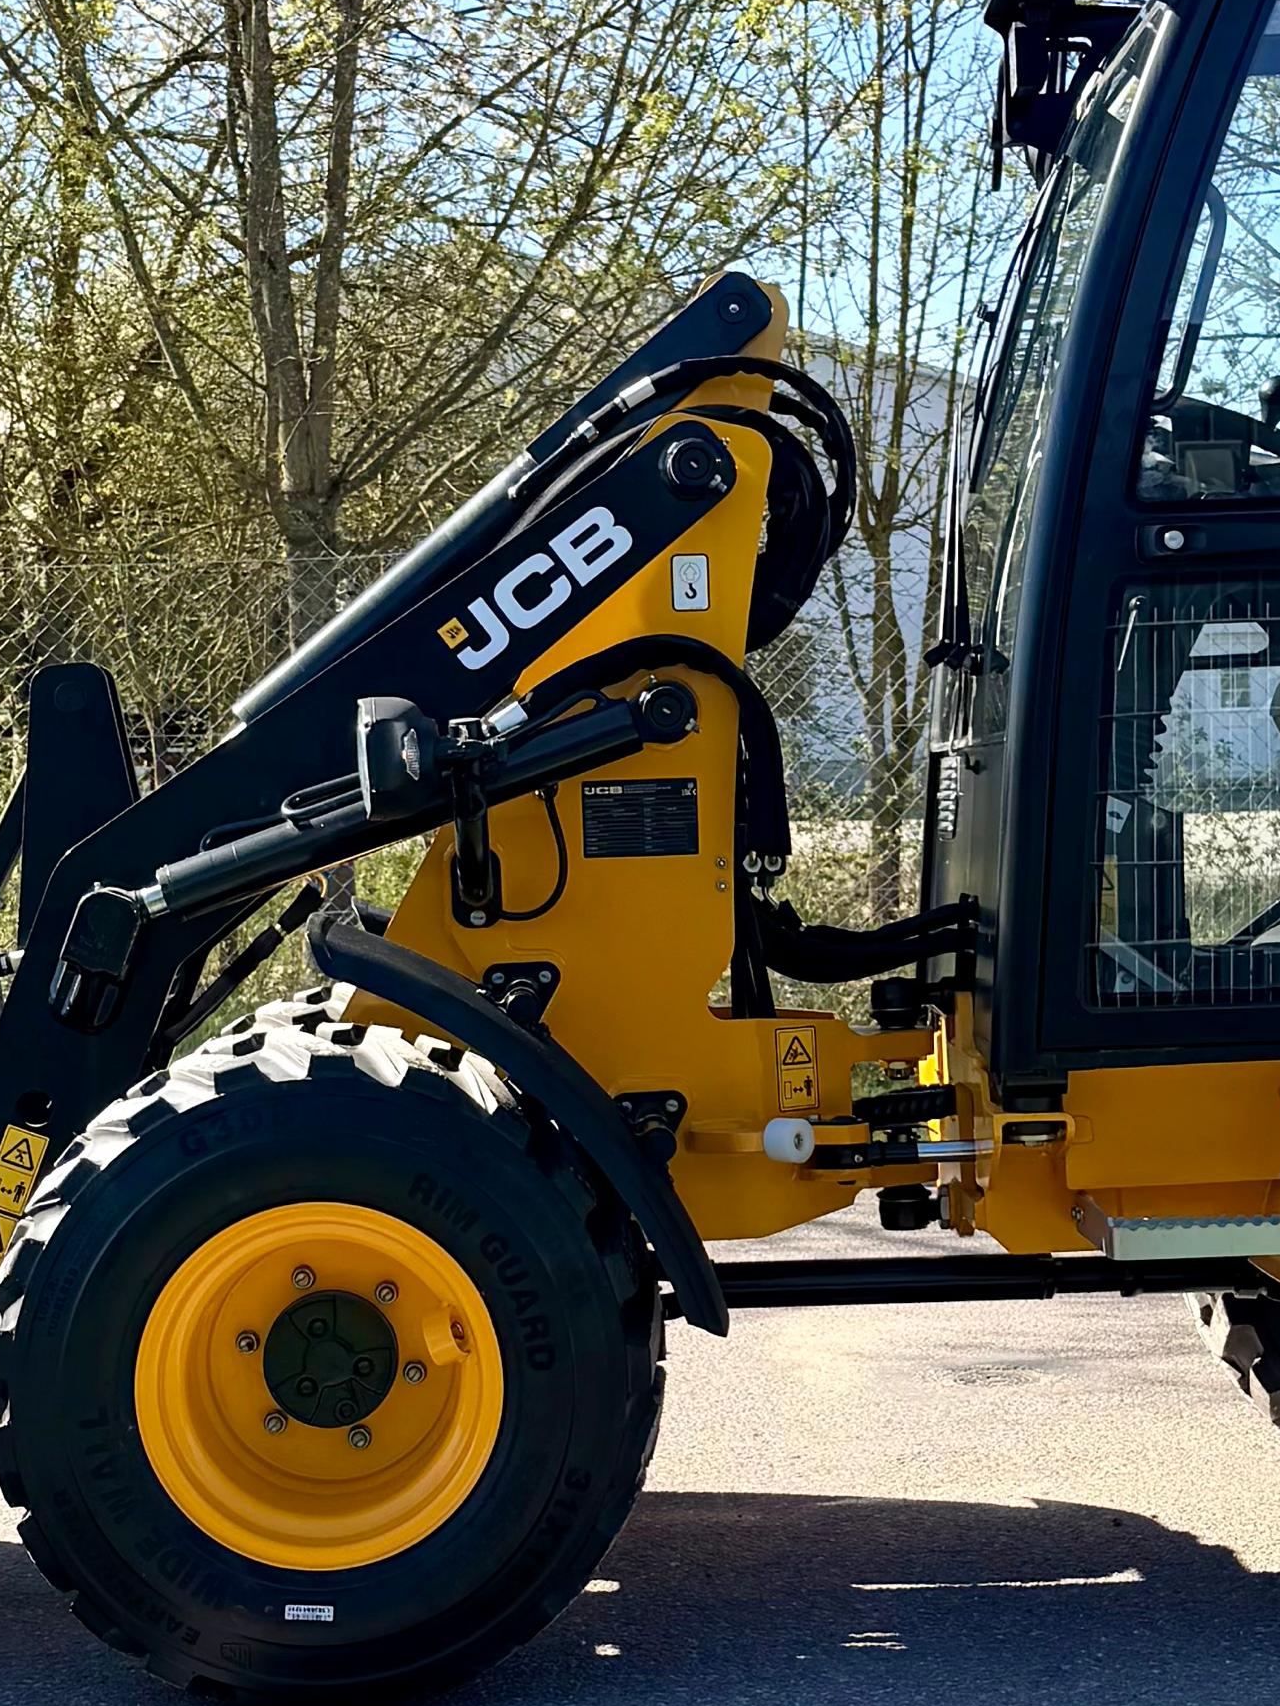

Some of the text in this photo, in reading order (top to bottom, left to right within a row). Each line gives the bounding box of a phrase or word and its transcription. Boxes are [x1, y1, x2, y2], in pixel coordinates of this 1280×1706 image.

[456, 506, 633, 670] JCB
[584, 786, 623, 795] JCB
[408, 1173, 480, 1233] RIM
[480, 1231, 557, 1371] GUARD
